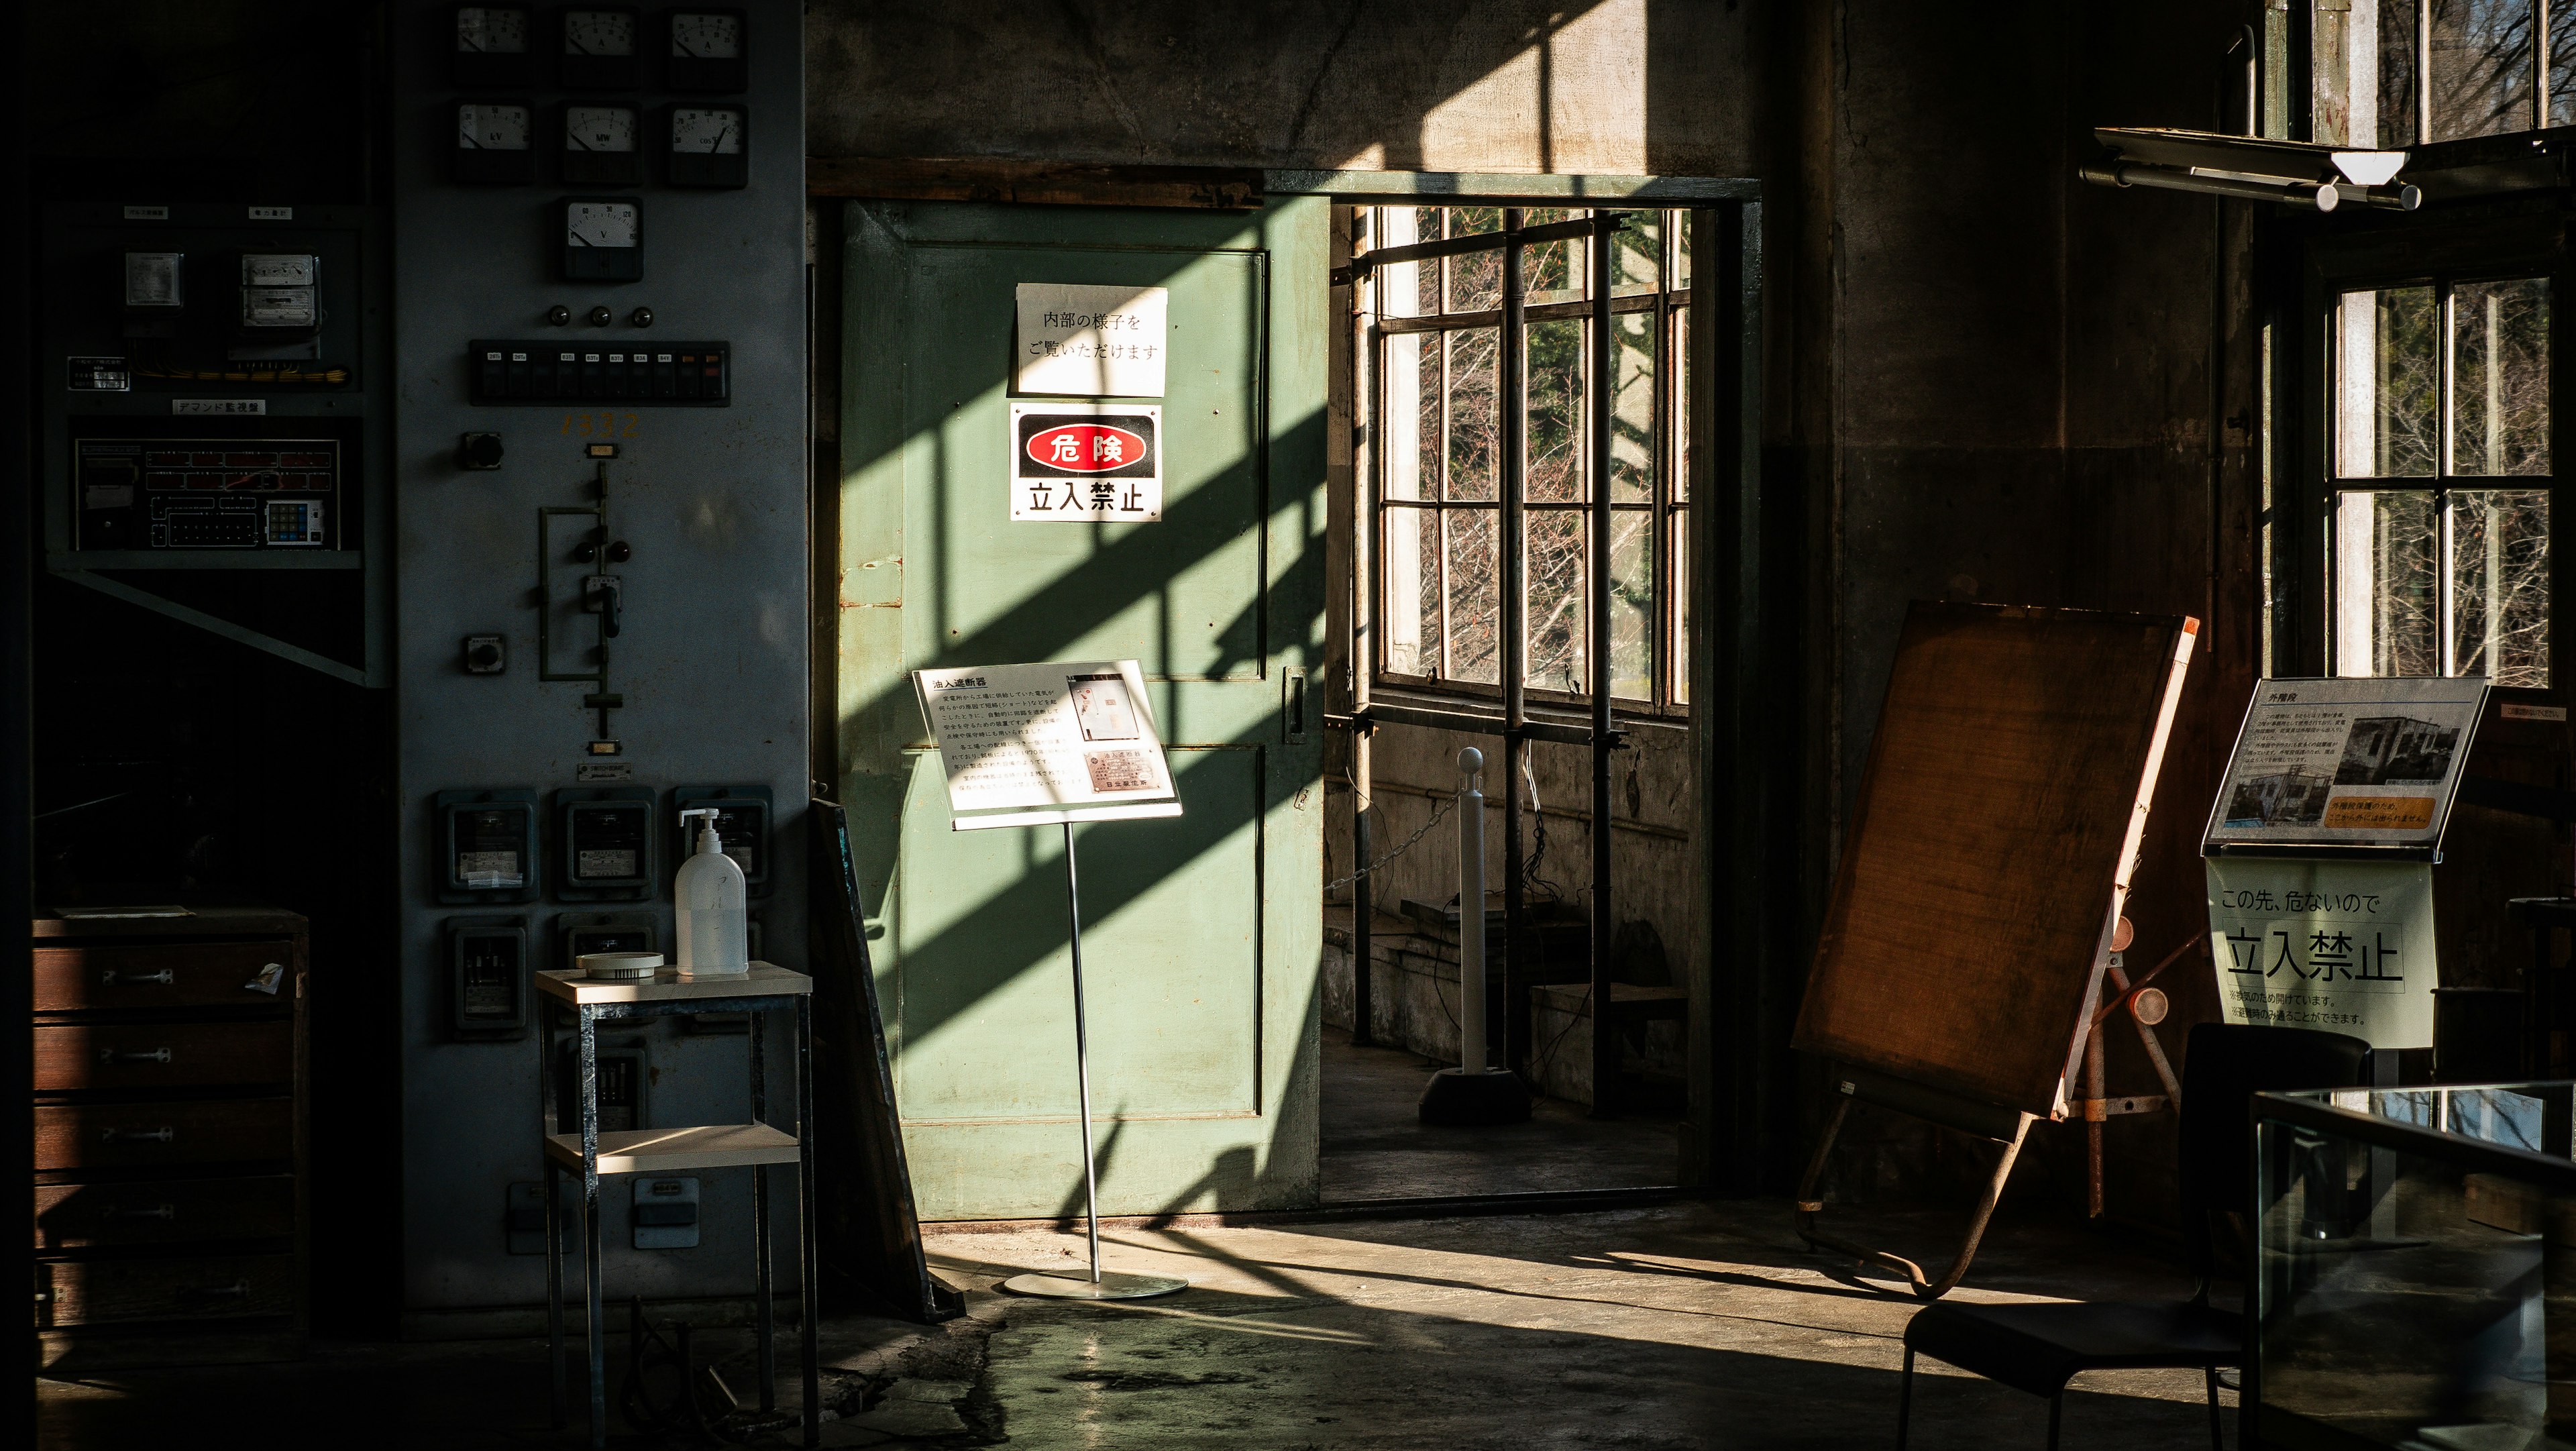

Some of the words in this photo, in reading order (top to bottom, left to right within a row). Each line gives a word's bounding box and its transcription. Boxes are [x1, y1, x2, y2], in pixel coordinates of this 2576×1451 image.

[704, 41, 710, 49] A
[596, 133, 610, 142] MW
[1043, 311, 1140, 330] 内部の様子を
[1029, 341, 1159, 360] ご覧いただけます
[179, 402, 258, 413] デマンド監視盤
[561, 413, 639, 437] 1332
[1051, 434, 1123, 463] 危険
[1029, 482, 1144, 511] 立入禁止
[932, 677, 987, 689] 油入遮断器
[943, 690, 1055, 702] 変電所から工場に供給していた電気が
[2268, 693, 2298, 702] 外階段
[941, 708, 1059, 720] こしたときに、自動的に回路を遮断して
[2331, 802, 2398, 810] 外階段保護のため、
[2328, 814, 2427, 823] ここから外には出られません。
[2222, 890, 2380, 913] この先、危ないので
[2226, 927, 2403, 981] 立入禁止
